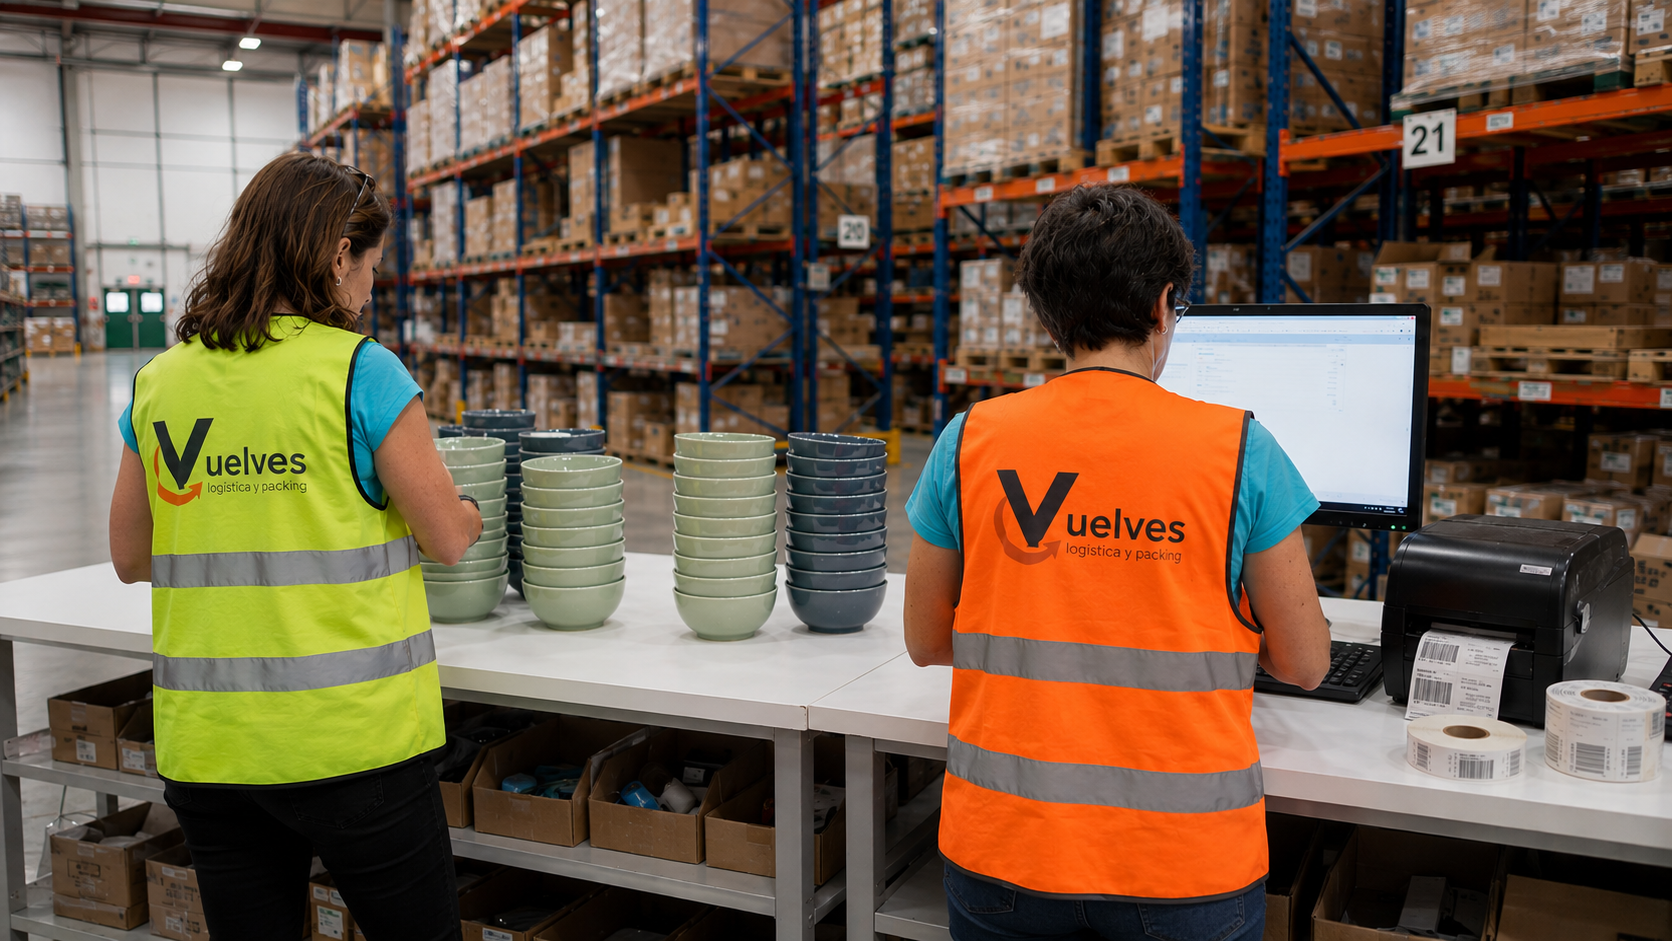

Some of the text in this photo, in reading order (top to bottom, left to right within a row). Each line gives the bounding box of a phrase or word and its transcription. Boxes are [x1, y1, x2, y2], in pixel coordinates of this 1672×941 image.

[1411, 121, 1443, 156] 21
[843, 221, 865, 241] 20
[253, 483, 260, 494] y
[261, 479, 307, 494] packing
[1124, 550, 1132, 561] y
[1135, 549, 1182, 564] packing
